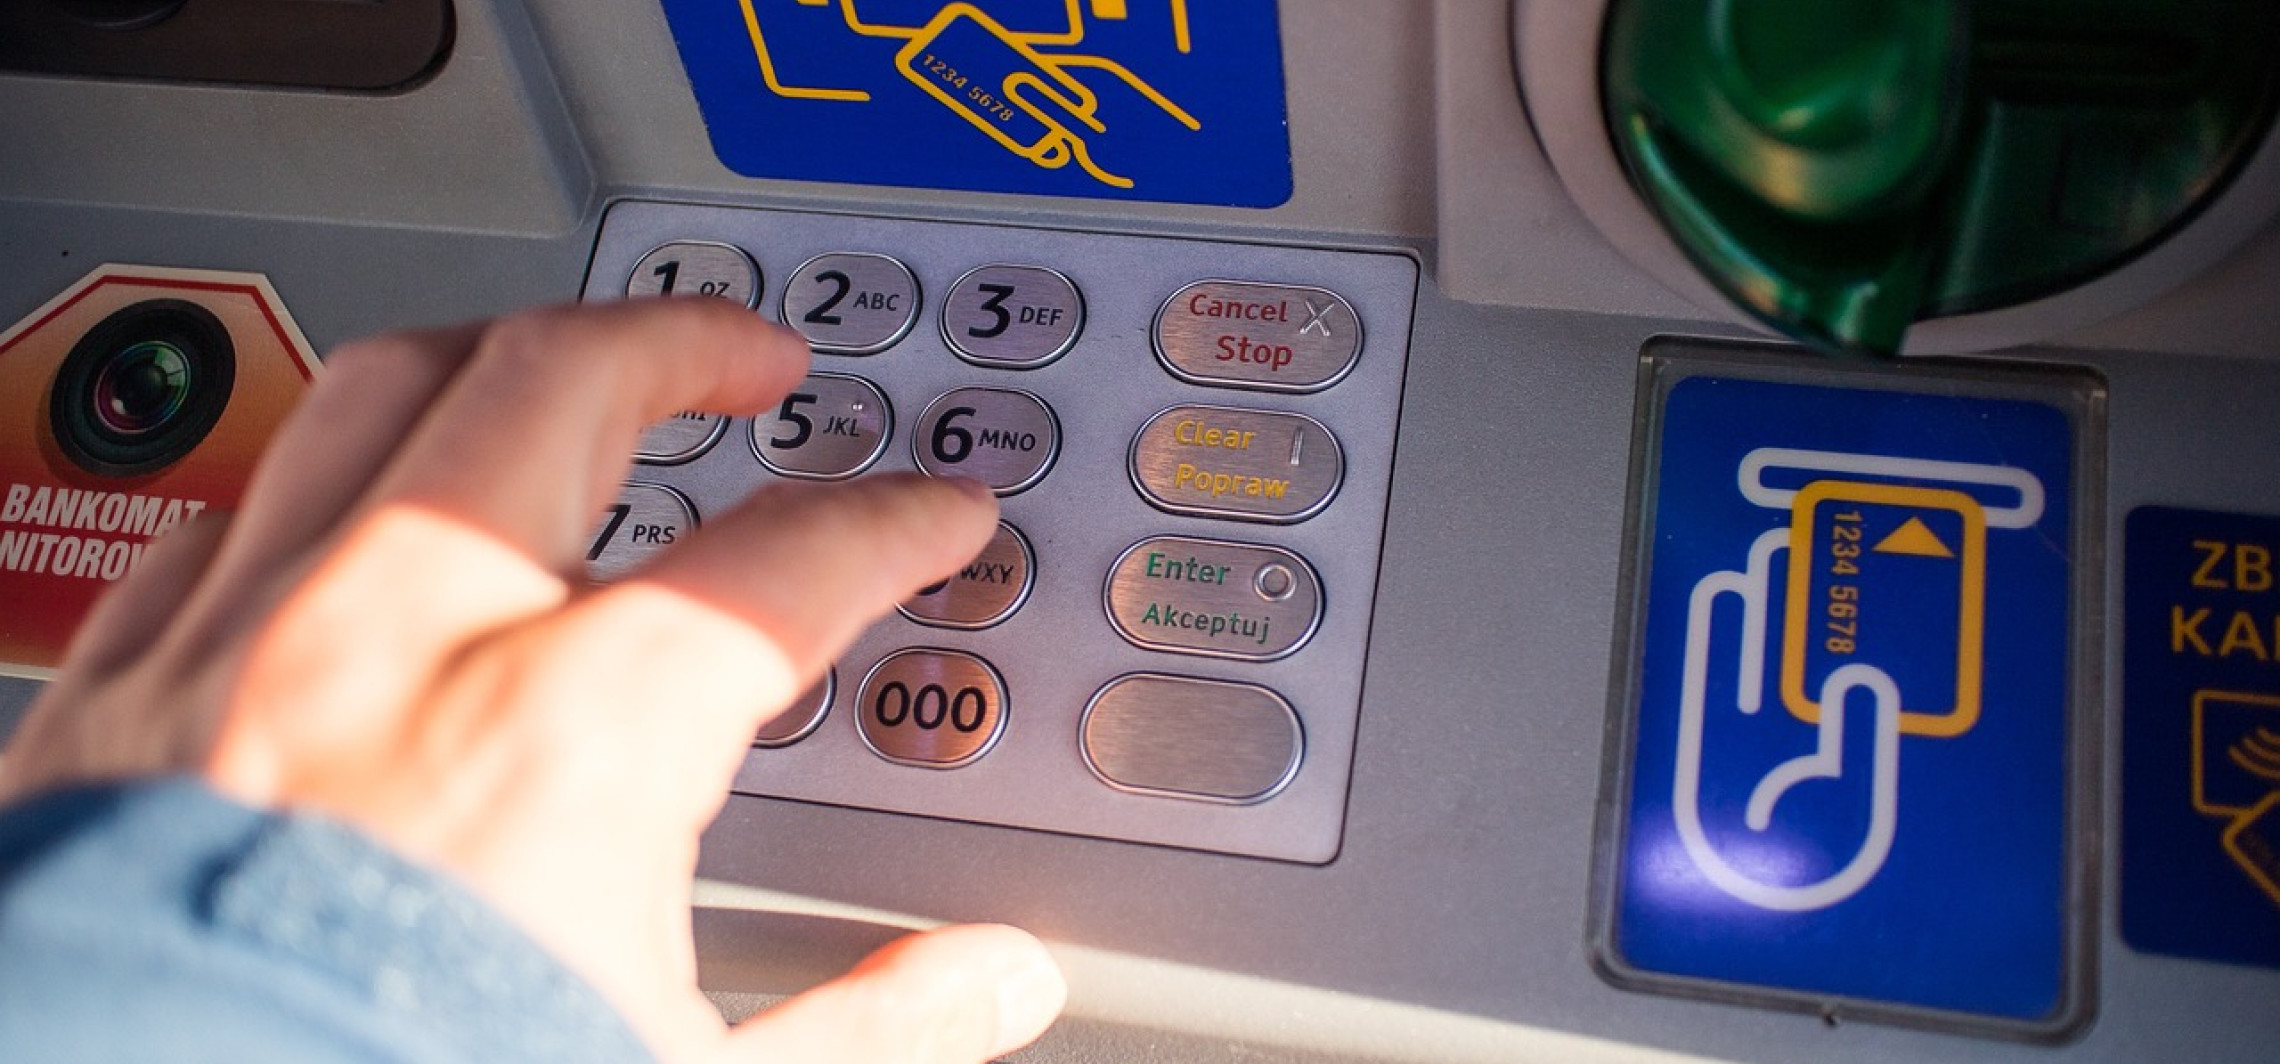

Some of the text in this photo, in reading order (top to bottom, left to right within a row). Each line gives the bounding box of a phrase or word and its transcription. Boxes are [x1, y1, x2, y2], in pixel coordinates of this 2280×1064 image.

[923, 53, 1014, 121] 1234 5678
[653, 261, 680, 298] 1
[804, 269, 900, 326] 2 ABC
[968, 283, 1063, 338] 3 DEF
[1189, 293, 1288, 322] Cancel
[1215, 335, 1293, 371] Stop
[770, 393, 861, 449] 5 JKL
[931, 406, 1036, 463] 6 MNO
[1174, 420, 1255, 450] Clear
[1174, 463, 1291, 499] Popraw
[585, 504, 676, 560] 7 PRS
[961, 563, 1014, 584] WXY
[1146, 552, 1232, 585] Enter
[1825, 510, 1863, 654] 1234 5678
[1141, 603, 1271, 644] Akceptuj
[2172, 604, 2280, 663] KA
[875, 680, 986, 733] 000
